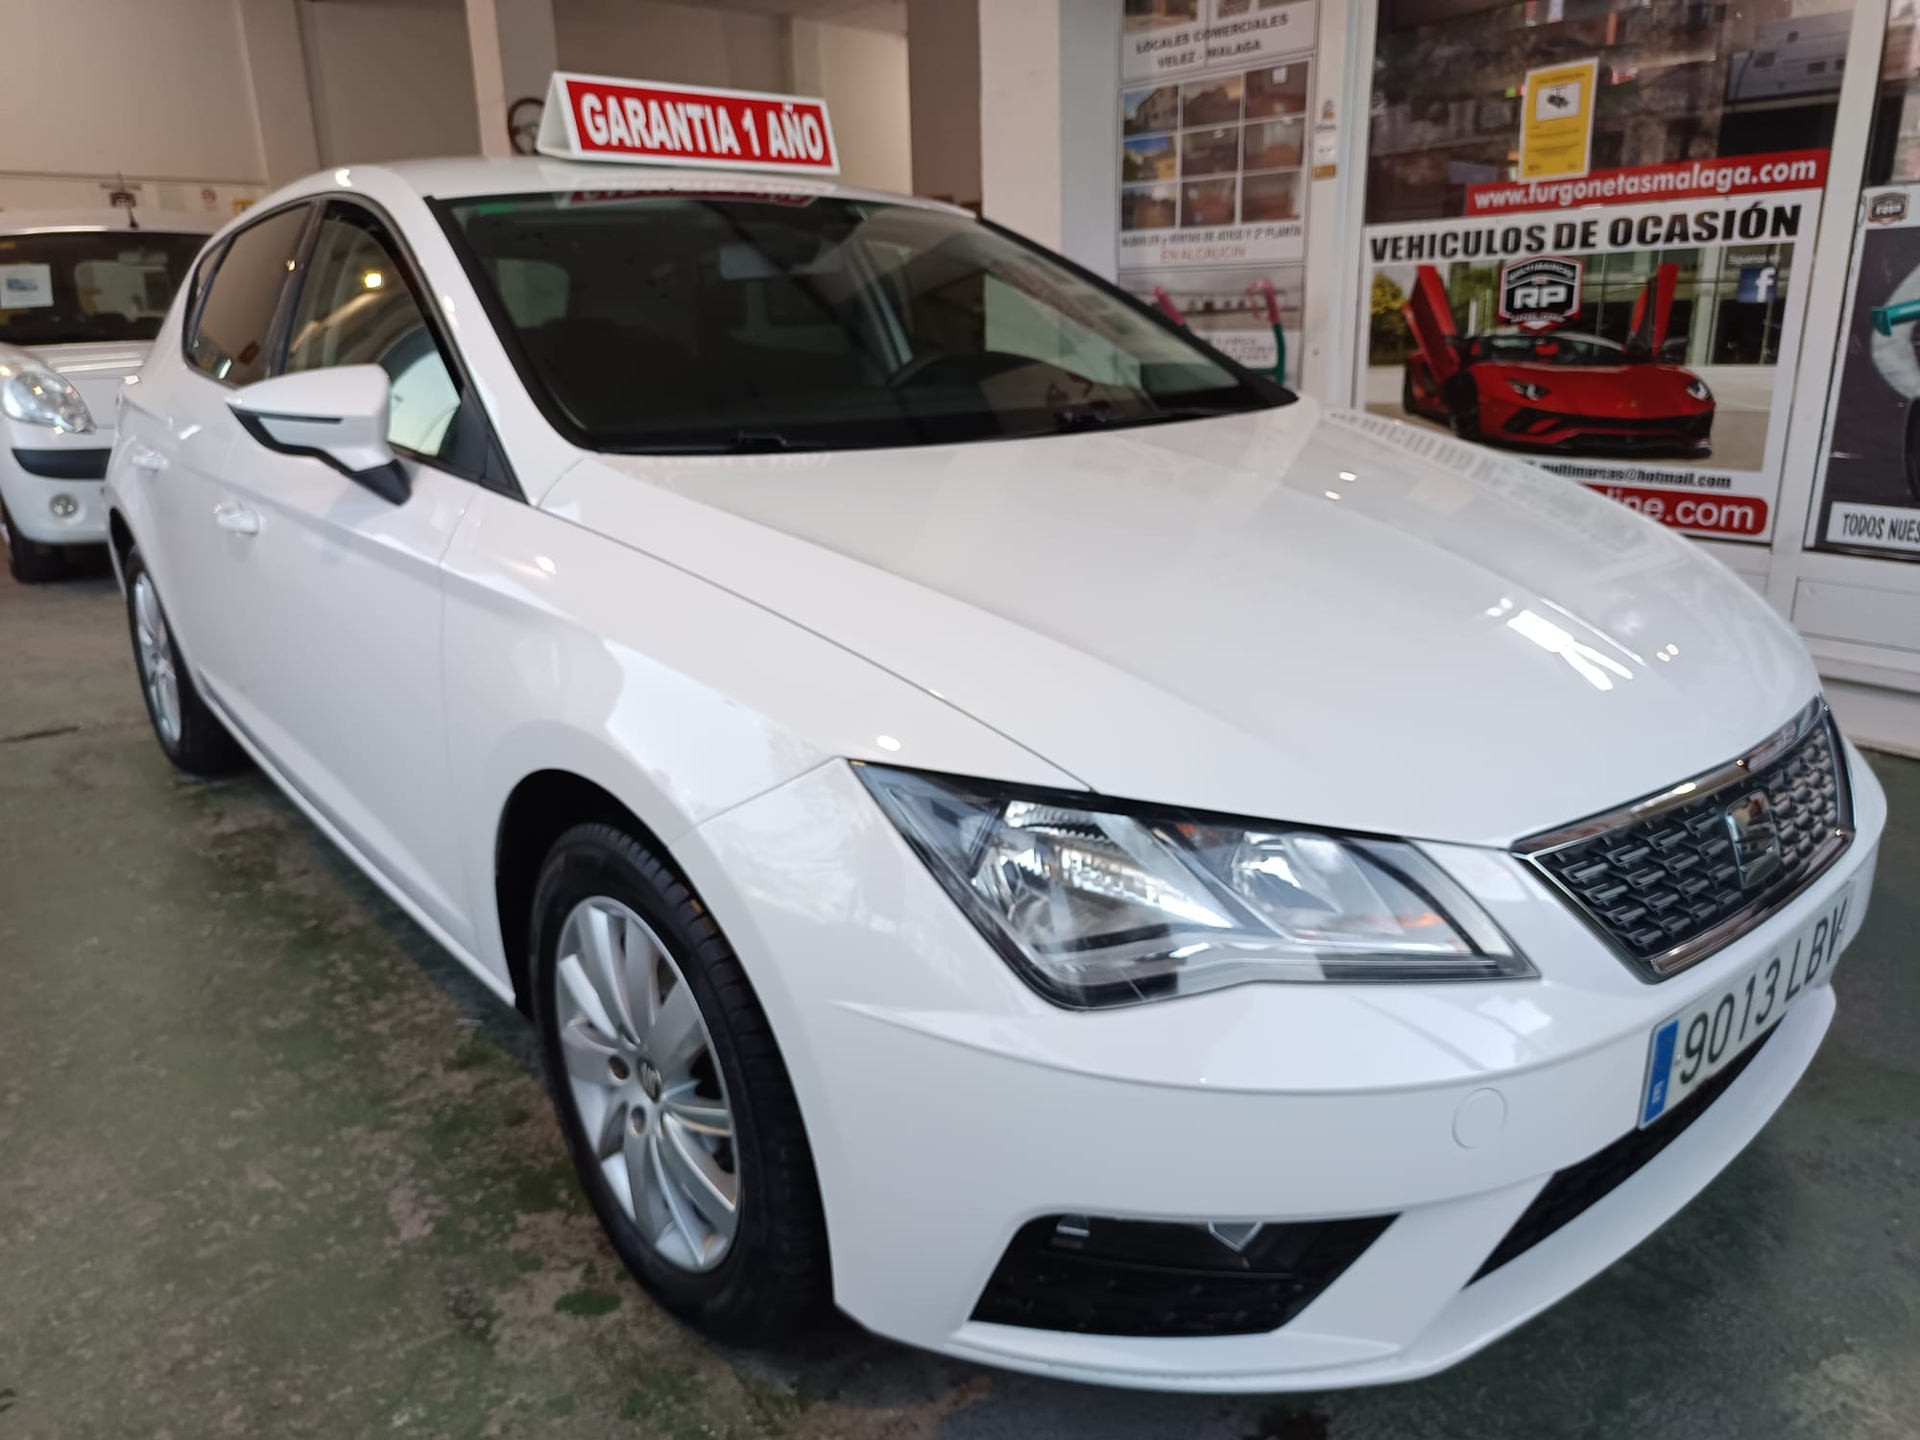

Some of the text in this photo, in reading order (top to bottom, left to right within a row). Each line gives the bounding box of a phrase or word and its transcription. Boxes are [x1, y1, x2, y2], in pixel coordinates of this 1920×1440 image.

[1136, 14, 1288, 54] LOCALES COMERCIALES
[1157, 51, 1196, 69] VELEZ
[1206, 40, 1262, 58] MALAGA
[581, 93, 824, 161] GARANTIA 1 AÑO
[1474, 159, 1816, 208] www.furgonetasmalaga.com
[1370, 201, 1802, 263] VEHICULOS DE OCASIÓN
[1513, 286, 1567, 309] RP
[1842, 512, 1885, 539] TODOS
[1679, 895, 1848, 1086] 9013 LBV
